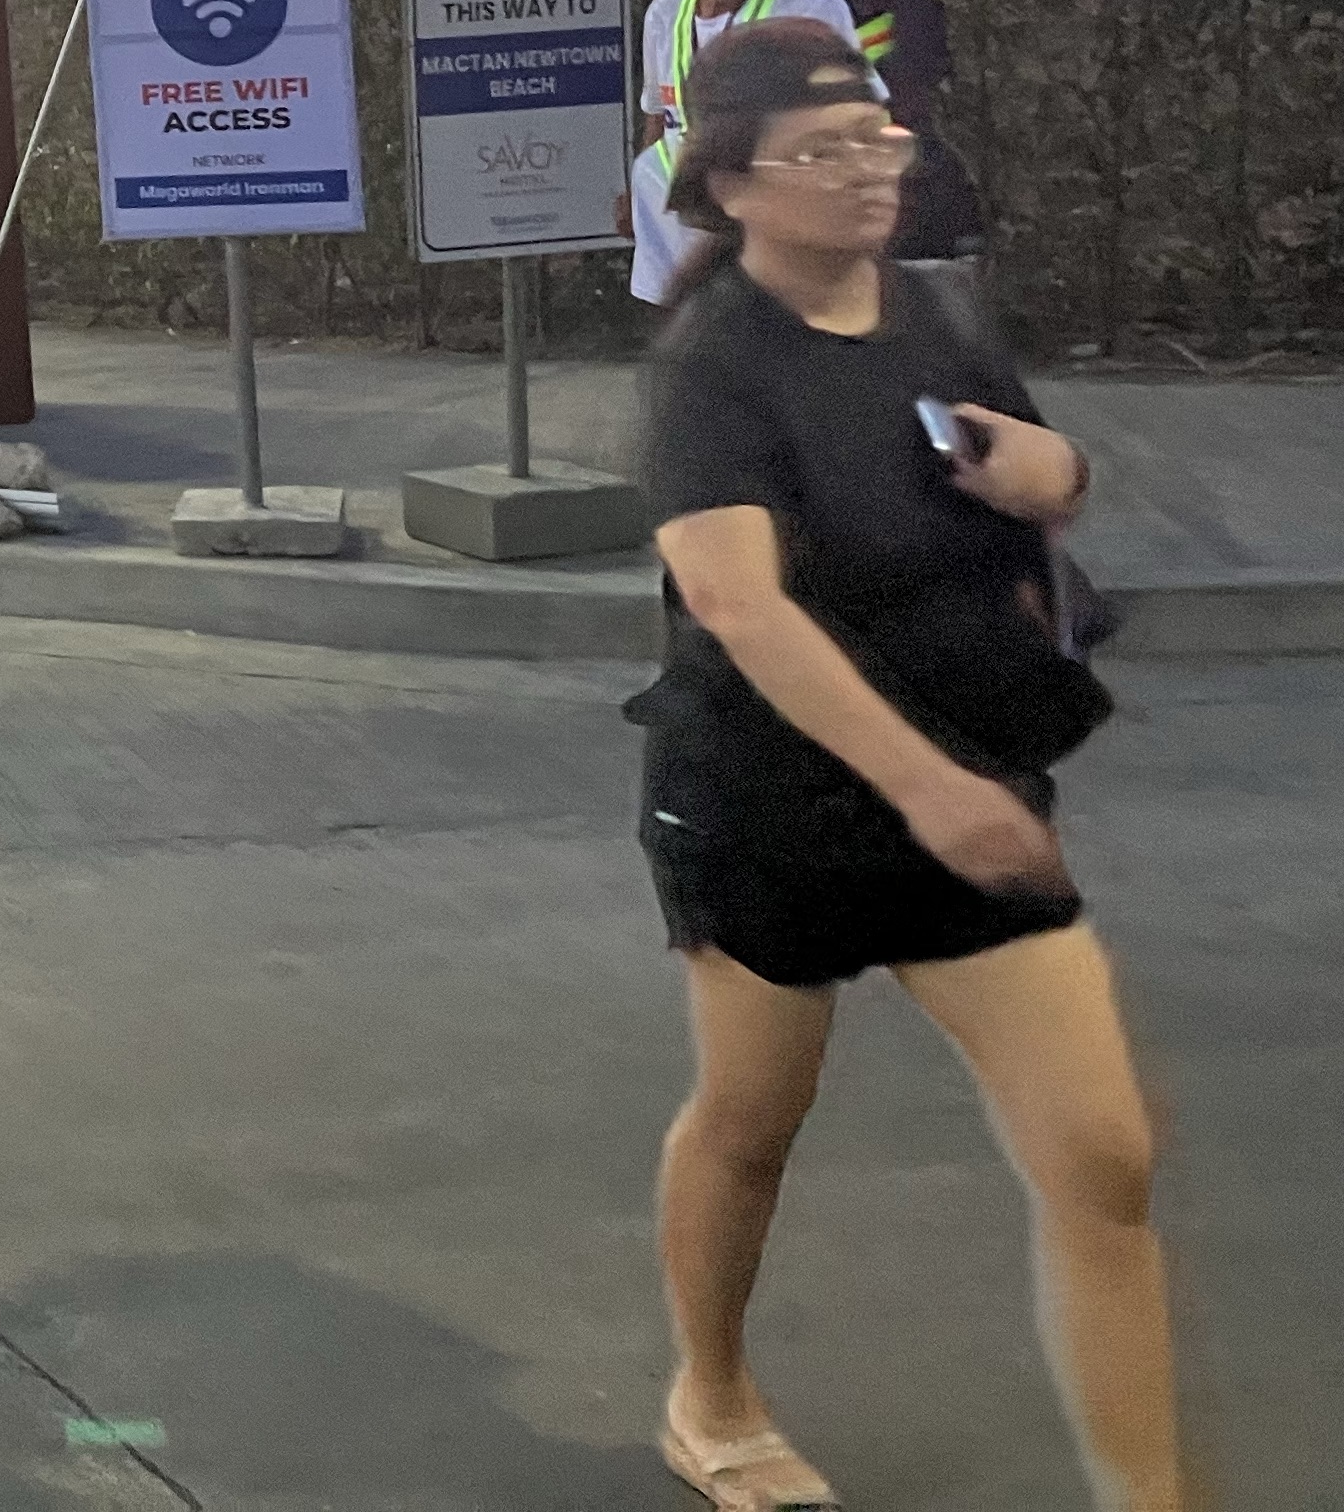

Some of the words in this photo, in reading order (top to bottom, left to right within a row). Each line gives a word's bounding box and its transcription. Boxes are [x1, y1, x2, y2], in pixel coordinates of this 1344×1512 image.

[443, 1, 495, 23] THIS
[422, 52, 510, 75] MACTAN
[514, 44, 621, 68] NEWTOWN
[141, 81, 224, 105] FREE
[233, 77, 309, 101] WIFI
[490, 77, 556, 98] BEACH
[163, 107, 291, 133] ACCESS
[192, 154, 265, 167] NETWORK
[477, 134, 568, 174] SAVOY
[139, 182, 240, 201] Megaworld
[244, 180, 324, 195] Ironman
